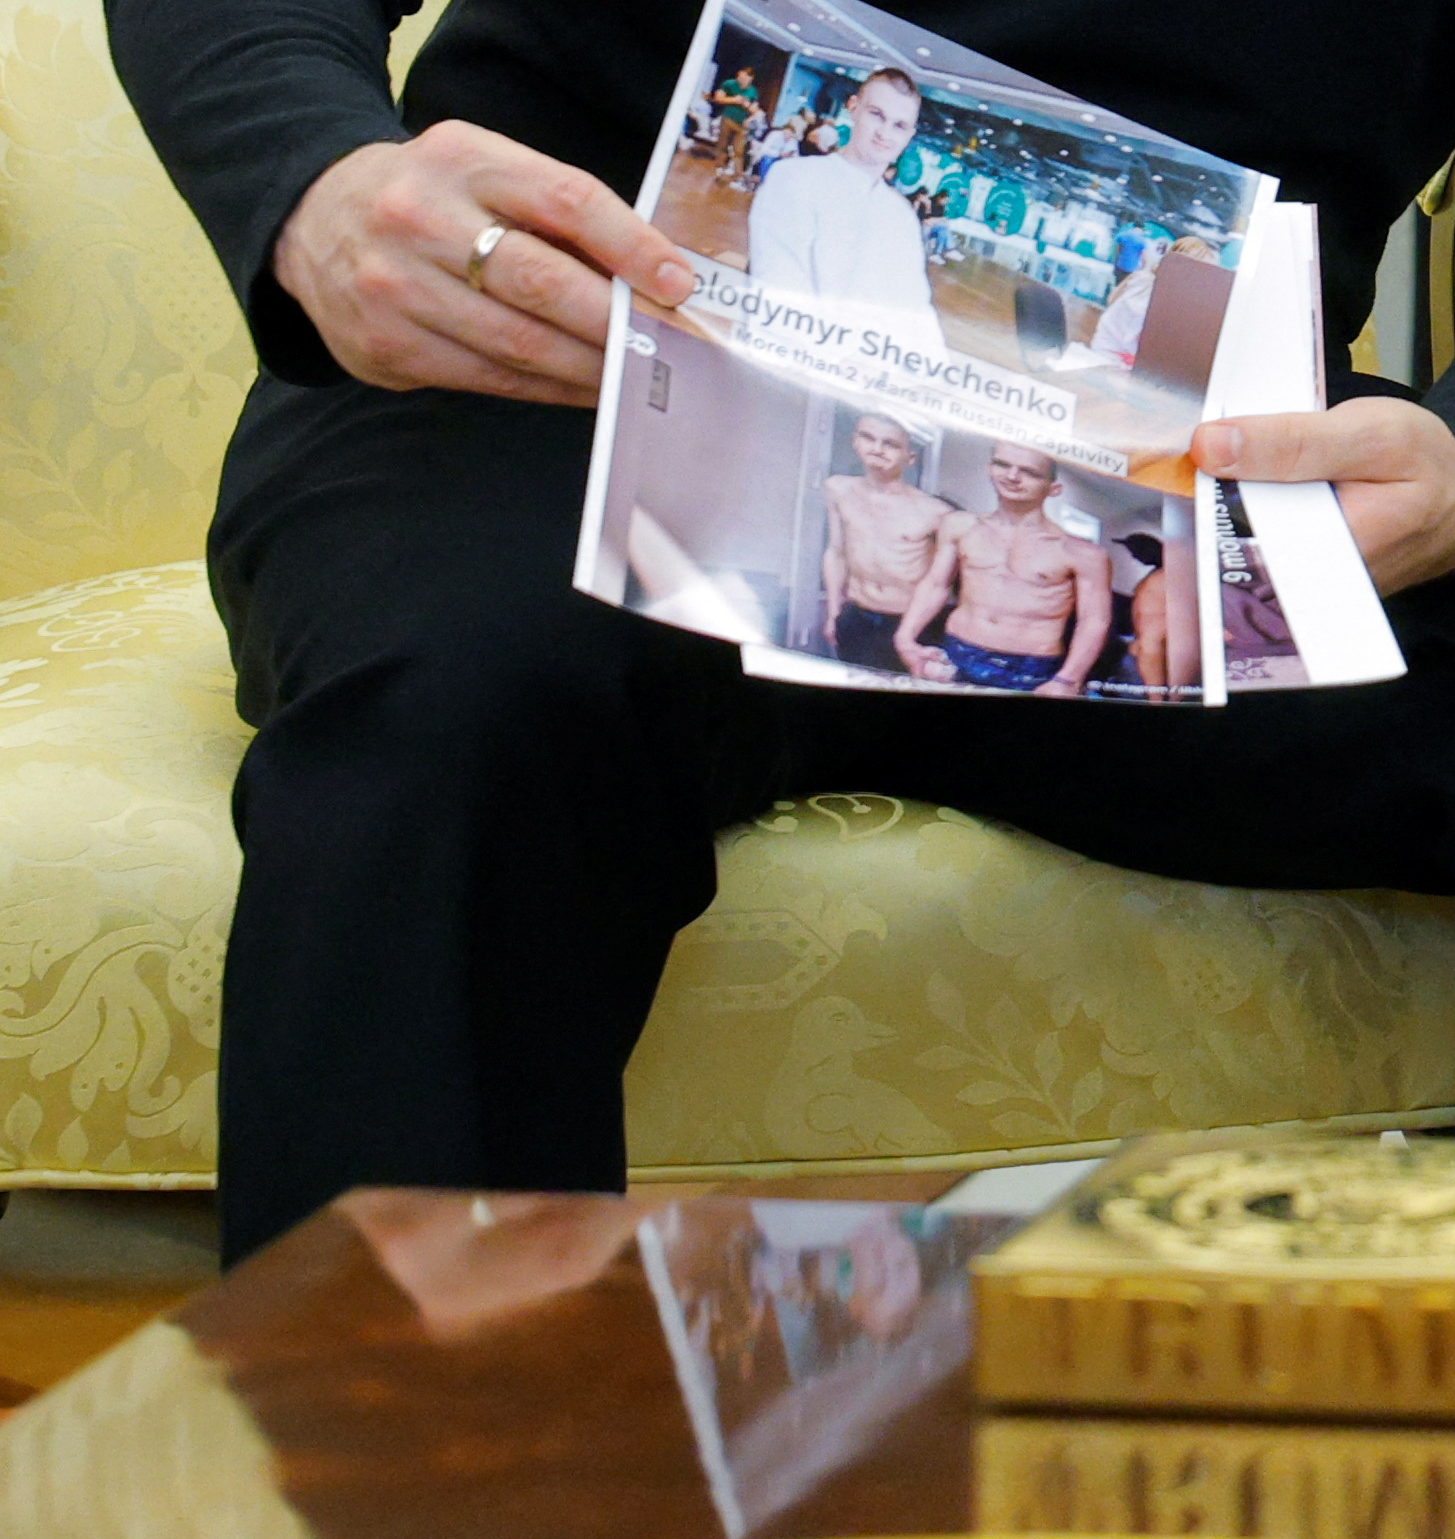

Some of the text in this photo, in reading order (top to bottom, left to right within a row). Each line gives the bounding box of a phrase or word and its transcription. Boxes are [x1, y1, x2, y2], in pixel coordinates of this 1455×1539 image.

[691, 271, 1067, 422] olodymyr Shevchenko
[736, 325, 1124, 473] More than 2 years in Russian captivity
[1222, 570, 1253, 583] 9
